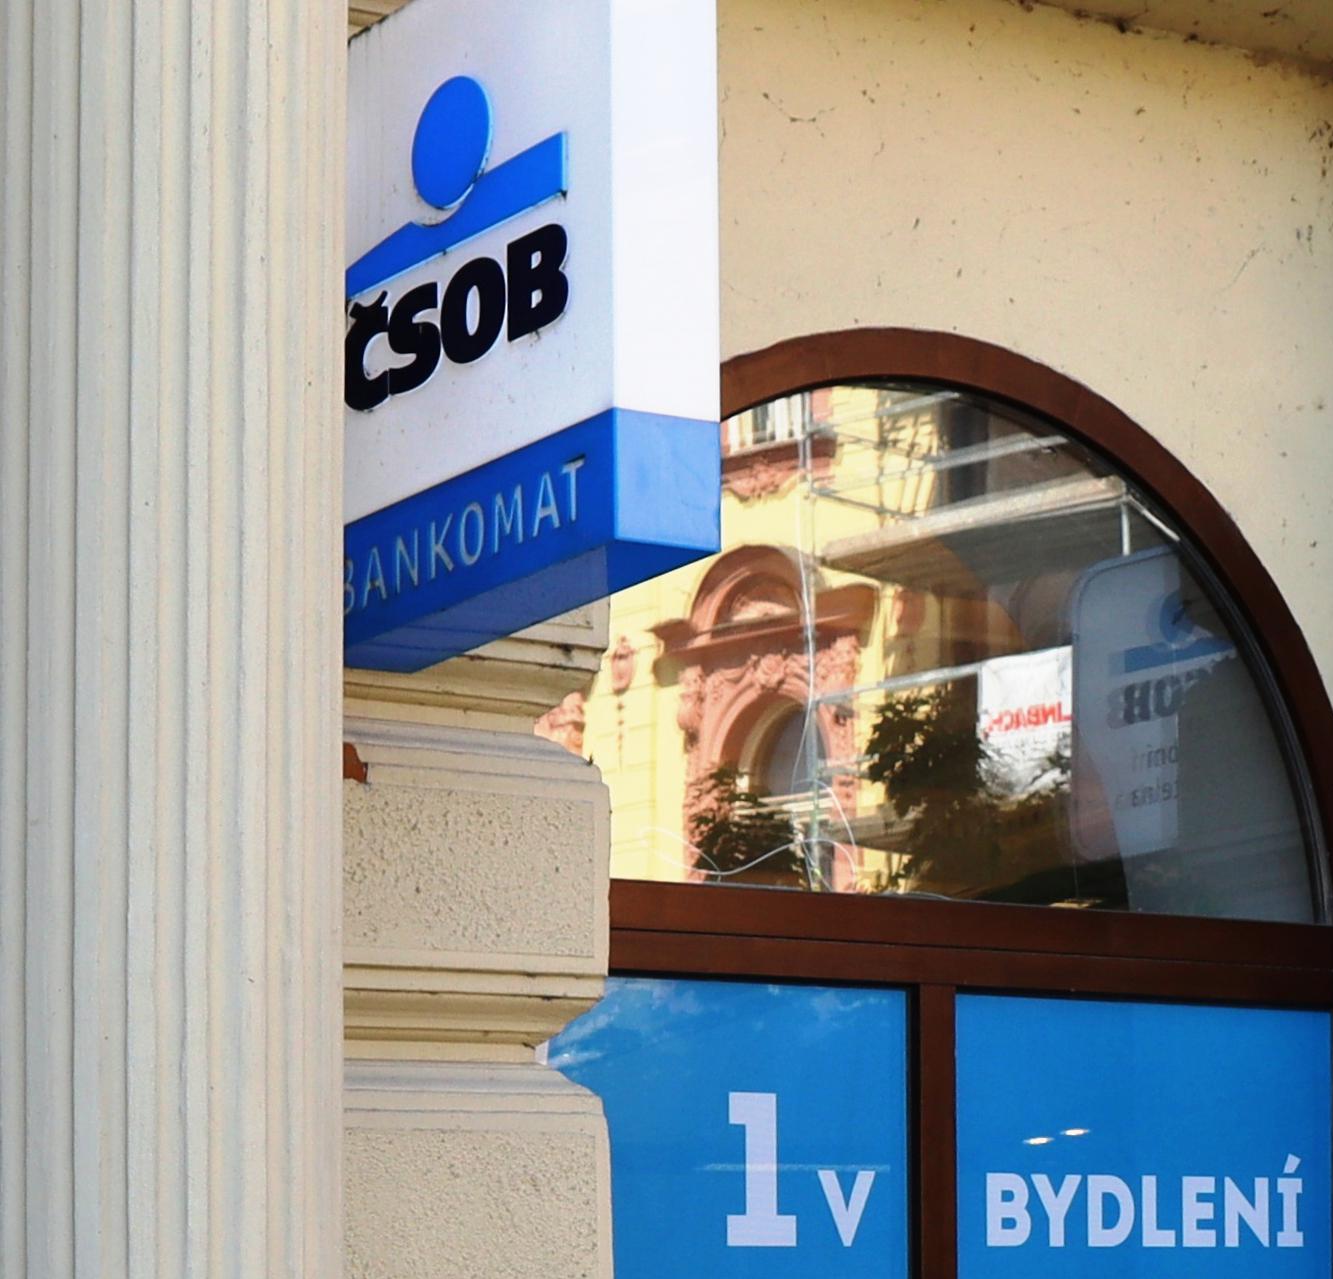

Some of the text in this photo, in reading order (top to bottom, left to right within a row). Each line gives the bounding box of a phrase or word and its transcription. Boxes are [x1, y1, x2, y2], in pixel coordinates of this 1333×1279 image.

[344, 223, 569, 412] ČSOB
[726, 1092, 797, 1247] 1
[986, 1153, 1304, 1247] BYDLENÍ
